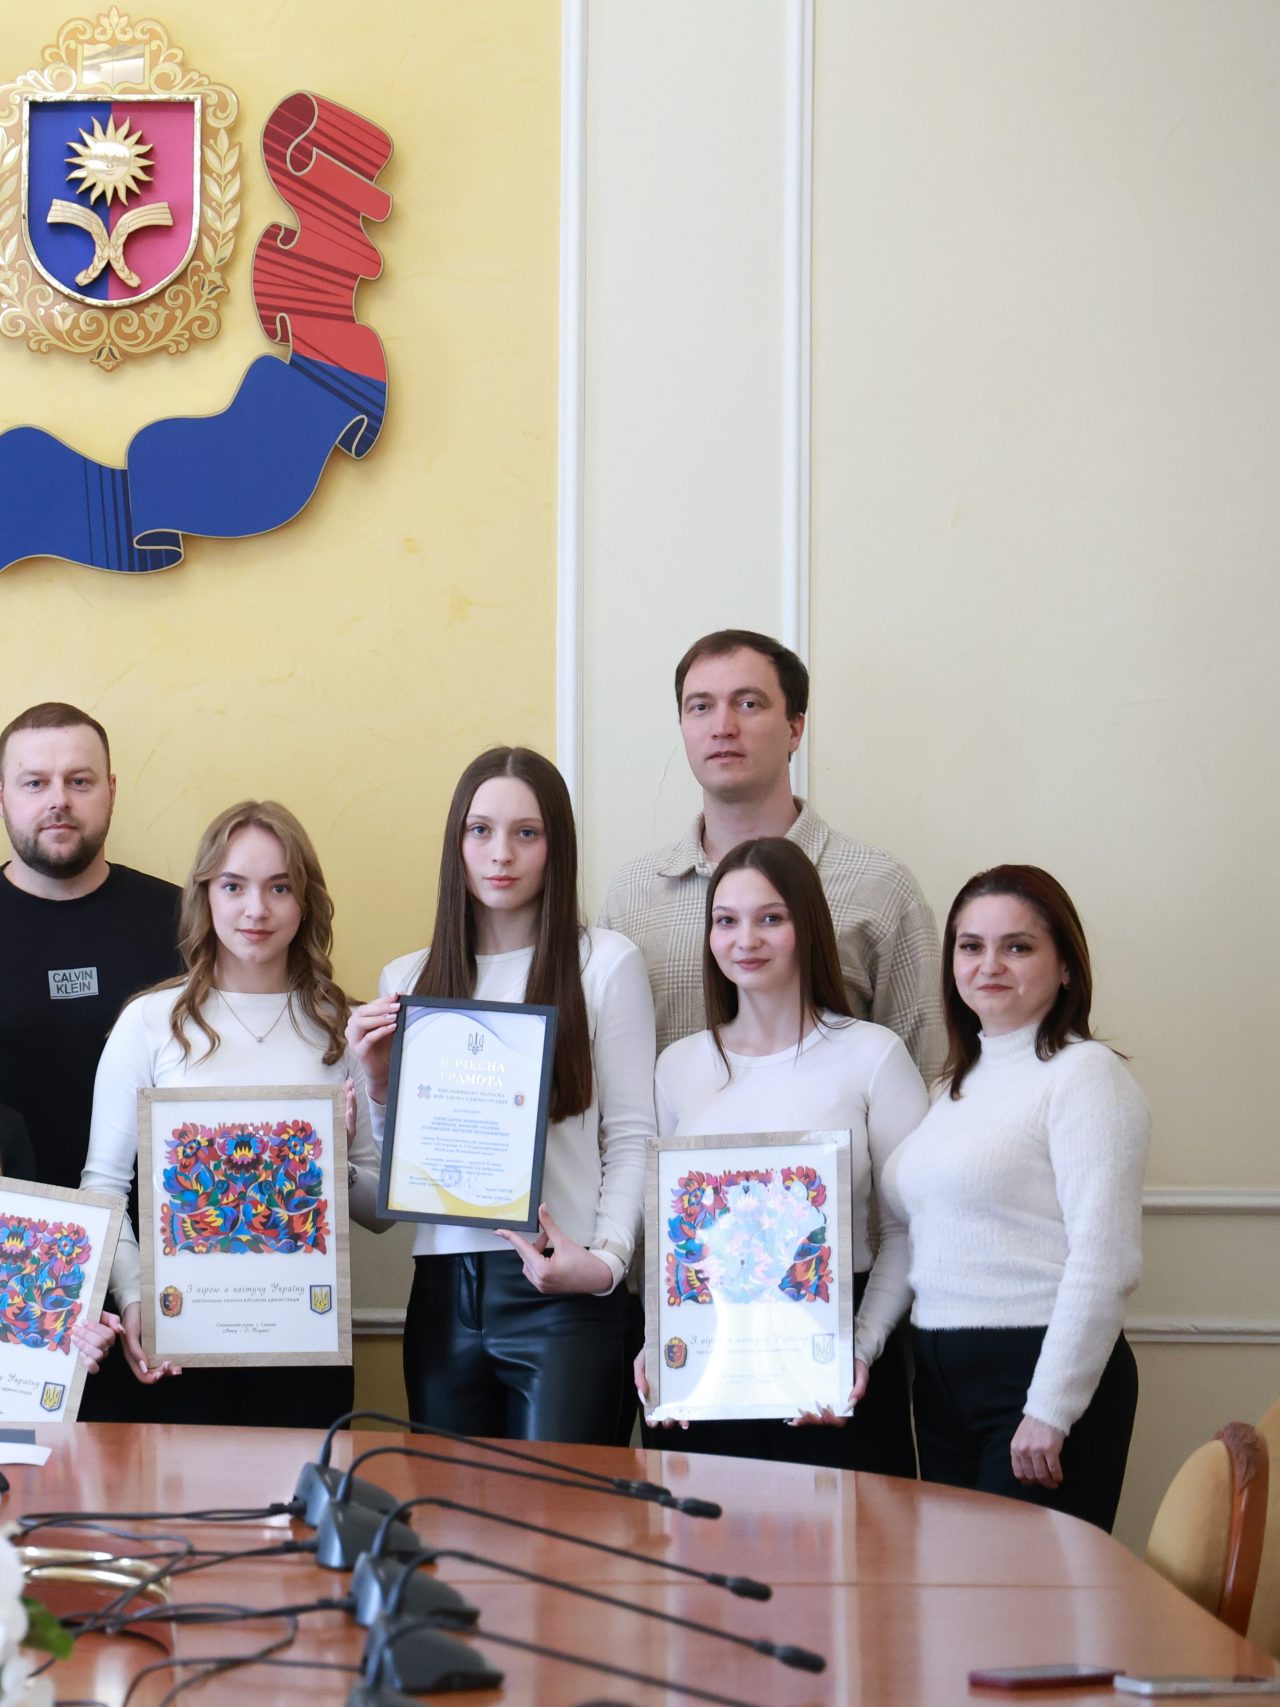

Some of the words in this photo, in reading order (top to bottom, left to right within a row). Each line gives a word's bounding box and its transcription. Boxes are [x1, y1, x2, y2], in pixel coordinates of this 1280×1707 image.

[52, 970, 93, 983] CALVIN
[56, 981, 91, 994] KLEIN
[439, 1057, 506, 1073] ПОЧЕСНА
[440, 1071, 504, 1087] ГРАМОТА
[186, 1284, 193, 1294] З
[233, 1286, 266, 1296] квітучу
[271, 1283, 305, 1296] Україну
[7, 1373, 40, 1390] Україну
